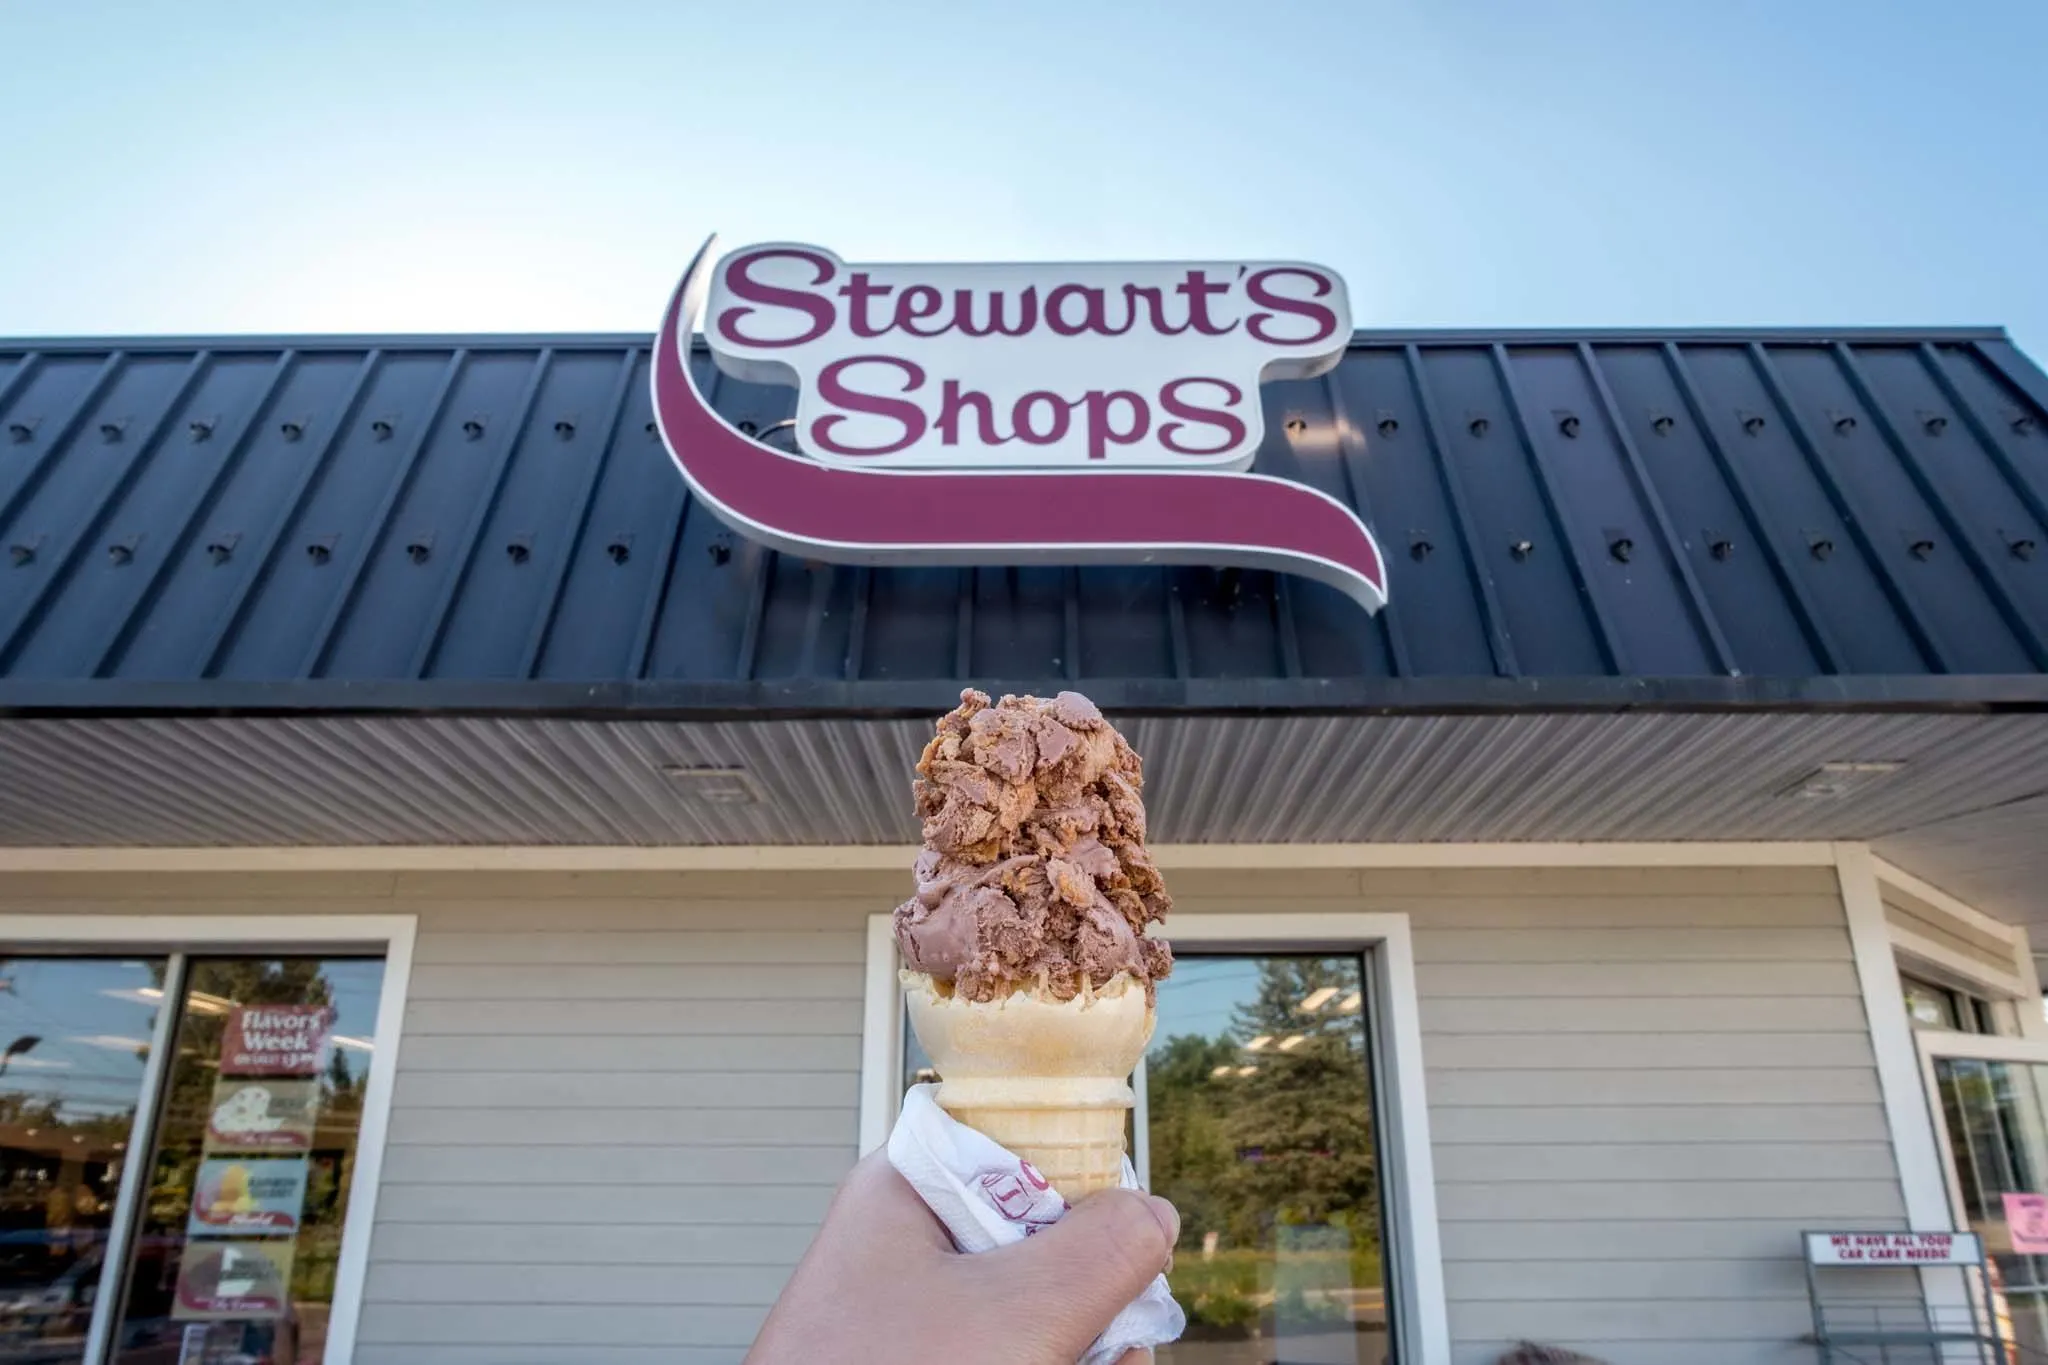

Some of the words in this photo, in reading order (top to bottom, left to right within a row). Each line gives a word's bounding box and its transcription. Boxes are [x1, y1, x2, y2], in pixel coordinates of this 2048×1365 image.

[244, 1032, 309, 1051] Week
[1831, 1235, 1849, 1247] WE
[1856, 1235, 1887, 1247] HAVE
[1894, 1235, 1914, 1247] ALL
[1919, 1234, 1954, 1247] YOUR
[1839, 1248, 1863, 1260] CAR
[1869, 1248, 1901, 1260] CARE
